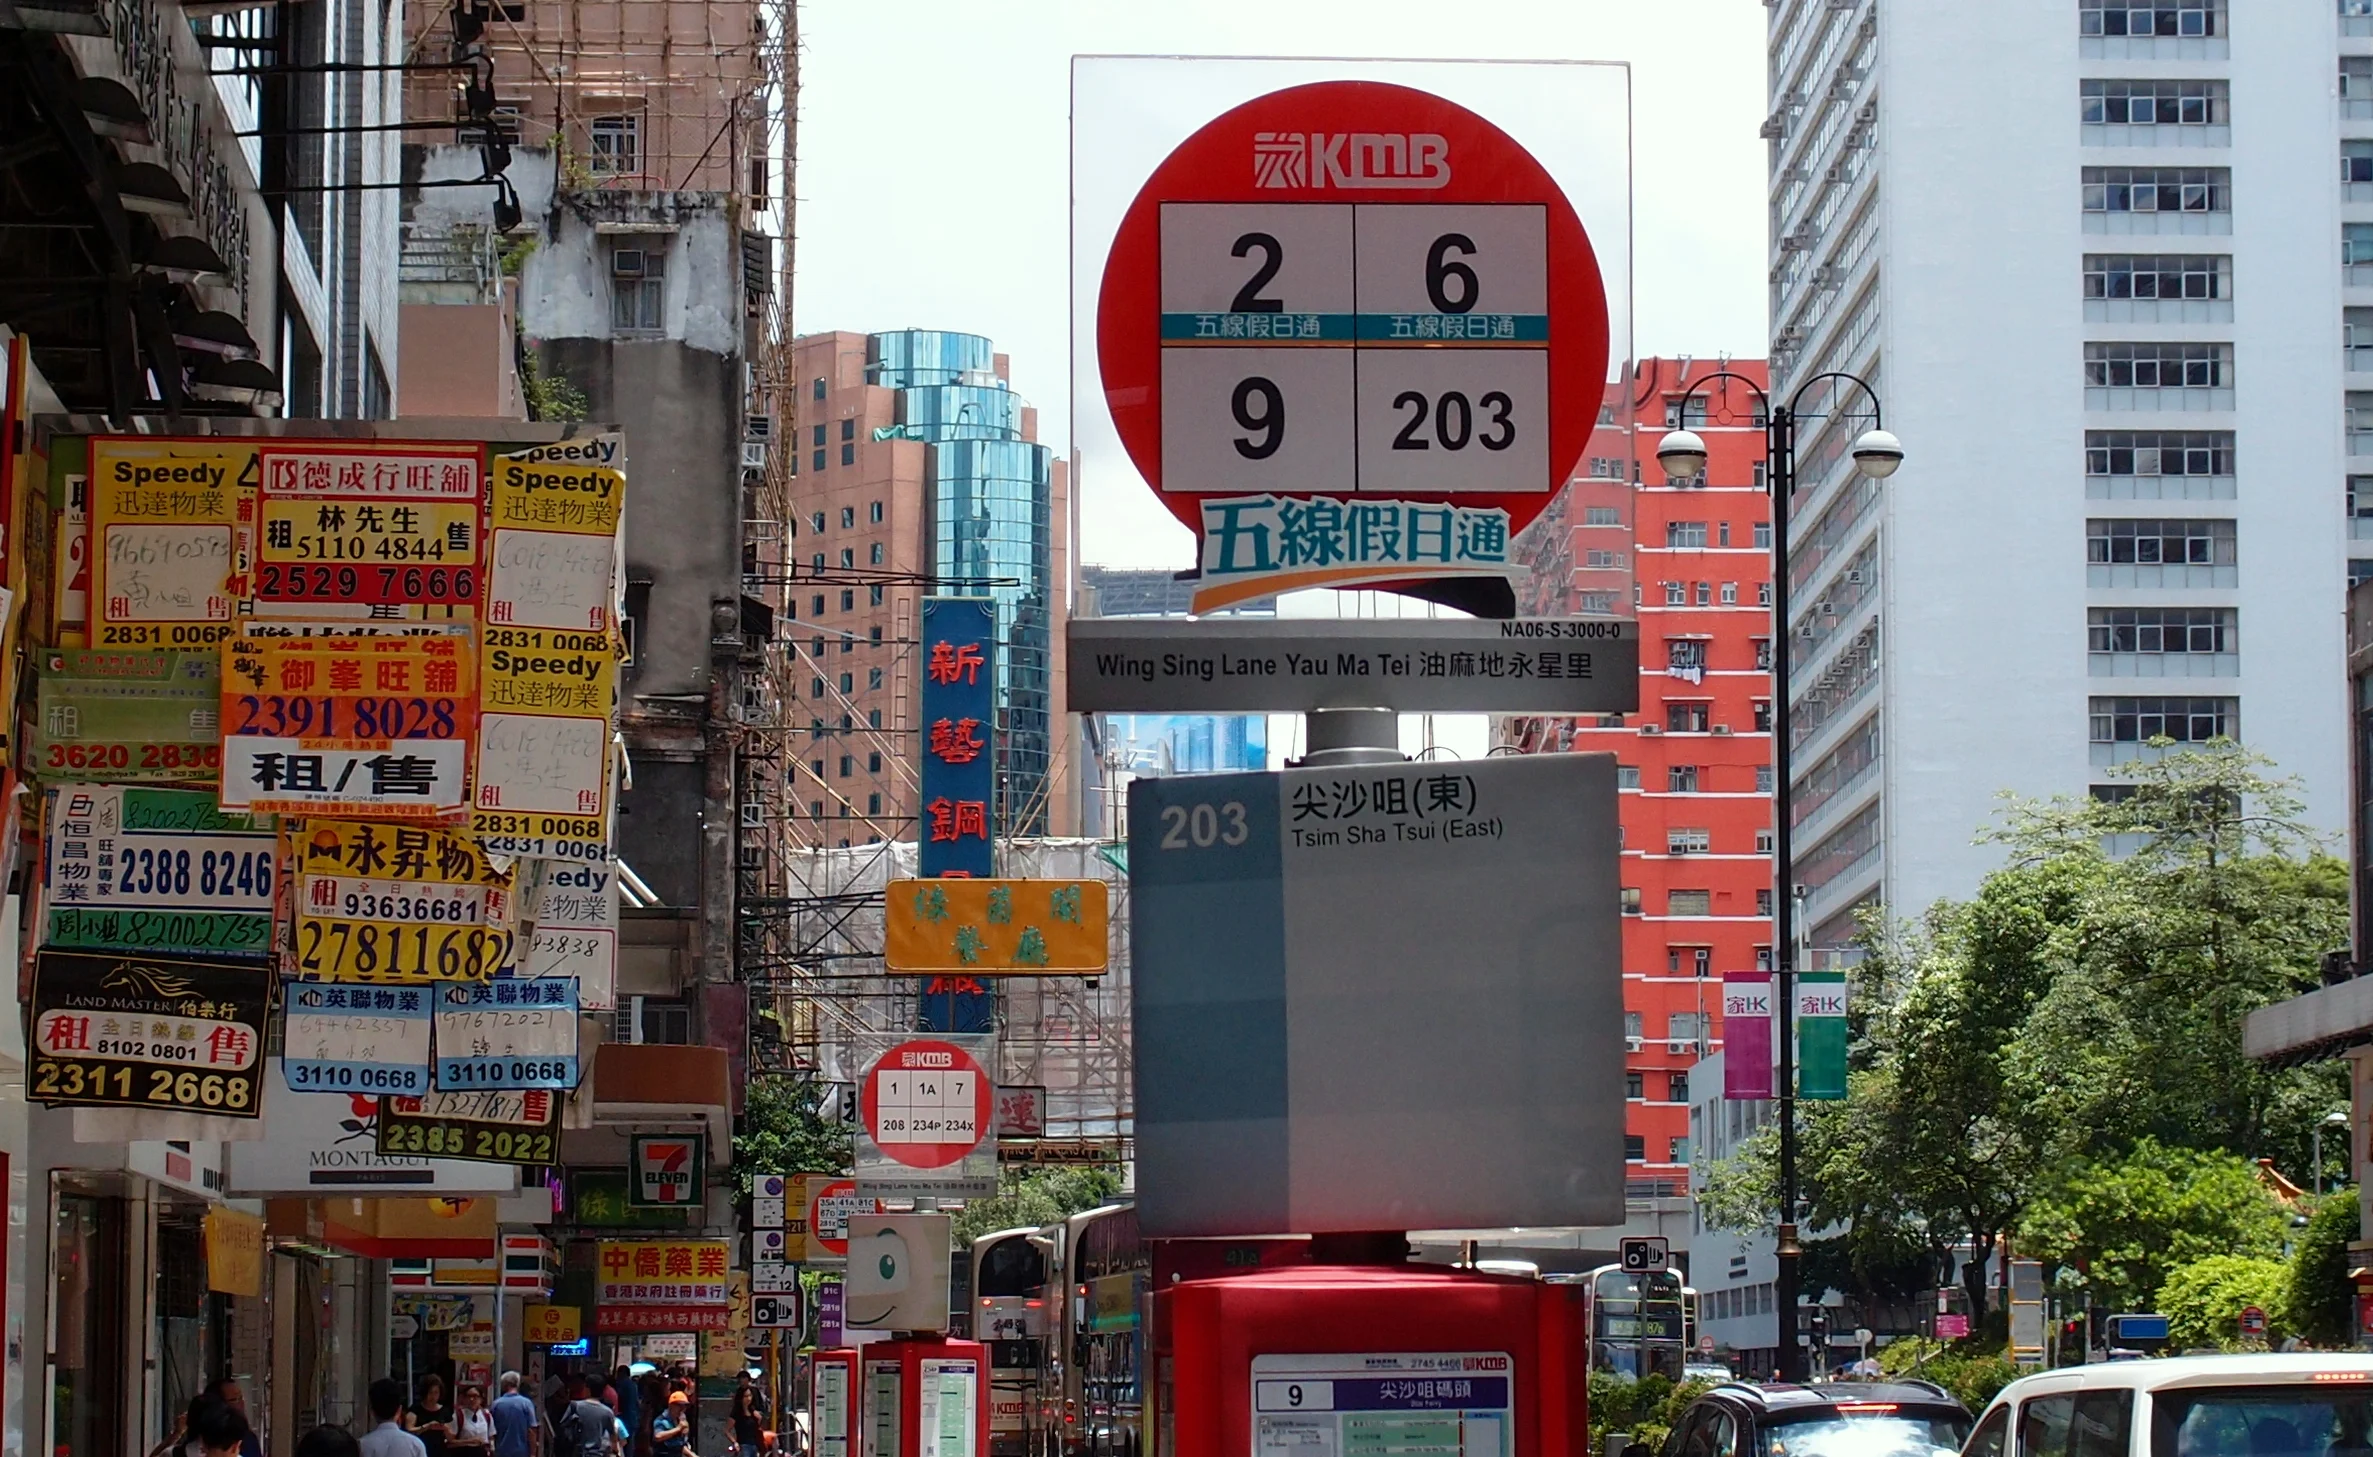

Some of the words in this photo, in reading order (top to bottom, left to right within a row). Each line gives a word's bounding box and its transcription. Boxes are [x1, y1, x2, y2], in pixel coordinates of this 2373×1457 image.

[1311, 133, 1451, 190] KMB
[1230, 233, 1284, 313] 2
[1425, 233, 1480, 314] 6
[1194, 314, 1321, 339] 五線假日通
[1389, 315, 1516, 340] 五線假日通
[1231, 377, 1285, 459] 9
[1391, 391, 1516, 451] 203
[114, 461, 226, 488] Speedy
[302, 460, 470, 494] 德成行旺舖
[505, 466, 615, 498] Speedy
[113, 490, 225, 516] 迅達物業
[502, 495, 612, 527] 迅達物業
[317, 504, 420, 536] 林先生
[267, 519, 292, 549] 租
[446, 522, 471, 551] 售
[1202, 499, 1508, 578] 五線假日通
[296, 535, 366, 560] 5110
[374, 537, 445, 561] 4844
[260, 565, 359, 597] 2529
[377, 567, 474, 600] 7666
[109, 596, 131, 619] 租
[206, 595, 228, 619] 售
[491, 600, 513, 622] 租
[103, 625, 161, 644] 2831
[171, 626, 230, 645] 0068
[485, 629, 542, 649] 2831
[553, 634, 609, 652] 0068
[1500, 622, 1621, 638] NA06-S-3000-0
[491, 650, 602, 682] Speedy
[1096, 652, 1154, 682] Wing
[1162, 652, 1215, 682] Sing
[1222, 652, 1277, 677] Lane
[1285, 652, 1329, 677] Yau
[1336, 652, 1371, 677] Ma
[1378, 652, 1411, 677] Tei
[1419, 651, 1594, 680] 油麻地永星里
[489, 678, 600, 710] 迅達物業
[48, 705, 80, 738] 租
[188, 708, 219, 741] 售
[235, 695, 337, 738] 2391
[353, 697, 456, 740] 8028
[47, 743, 129, 769] 3620
[140, 744, 221, 769] 2838
[479, 784, 501, 807] 租
[576, 789, 598, 812] 售
[1292, 773, 1477, 822] 尖沙咀(東)
[473, 814, 531, 835] 2831
[541, 817, 600, 838] 0068
[1160, 802, 1249, 850] 203
[1292, 826, 1340, 849] Tsim
[1346, 824, 1386, 845] Sha
[1393, 820, 1436, 842] Tsui
[1442, 817, 1504, 843] (East)
[488, 836, 545, 855] 2831
[119, 848, 191, 896] 2388
[200, 850, 271, 898] 8246
[310, 878, 338, 907] 租
[344, 893, 478, 923] 93636681
[540, 894, 608, 921] 物業
[325, 988, 421, 1011] 英聯物業
[471, 983, 566, 1005] 英聯物業
[43, 1014, 91, 1053] 租
[203, 1025, 251, 1066] 售
[97, 1039, 145, 1056] 8102
[151, 1043, 197, 1061] 0801
[916, 1052, 953, 1068] KMB
[35, 1062, 133, 1098] 2311
[148, 1069, 250, 1109] 2668
[295, 1065, 352, 1086] 3110
[360, 1067, 417, 1090] 0668
[448, 1062, 504, 1083] 3110
[511, 1061, 566, 1082] 0668
[890, 1082, 898, 1095] 1
[918, 1082, 937, 1095] 1A
[955, 1082, 964, 1095] 7
[523, 1090, 549, 1122] 售
[883, 1119, 905, 1131] 208
[912, 1120, 942, 1131] 234P
[945, 1120, 974, 1131] 234X
[386, 1124, 464, 1154] 2385
[475, 1131, 552, 1161] 2022
[603, 1246, 725, 1278] 中僑藥業
[779, 1280, 793, 1291] 12
[1410, 1359, 1435, 1369] 2745
[1475, 1357, 1508, 1371] KMB
[1288, 1384, 1303, 1407] 9
[1380, 1380, 1472, 1400] 尖沙咀碼頭
